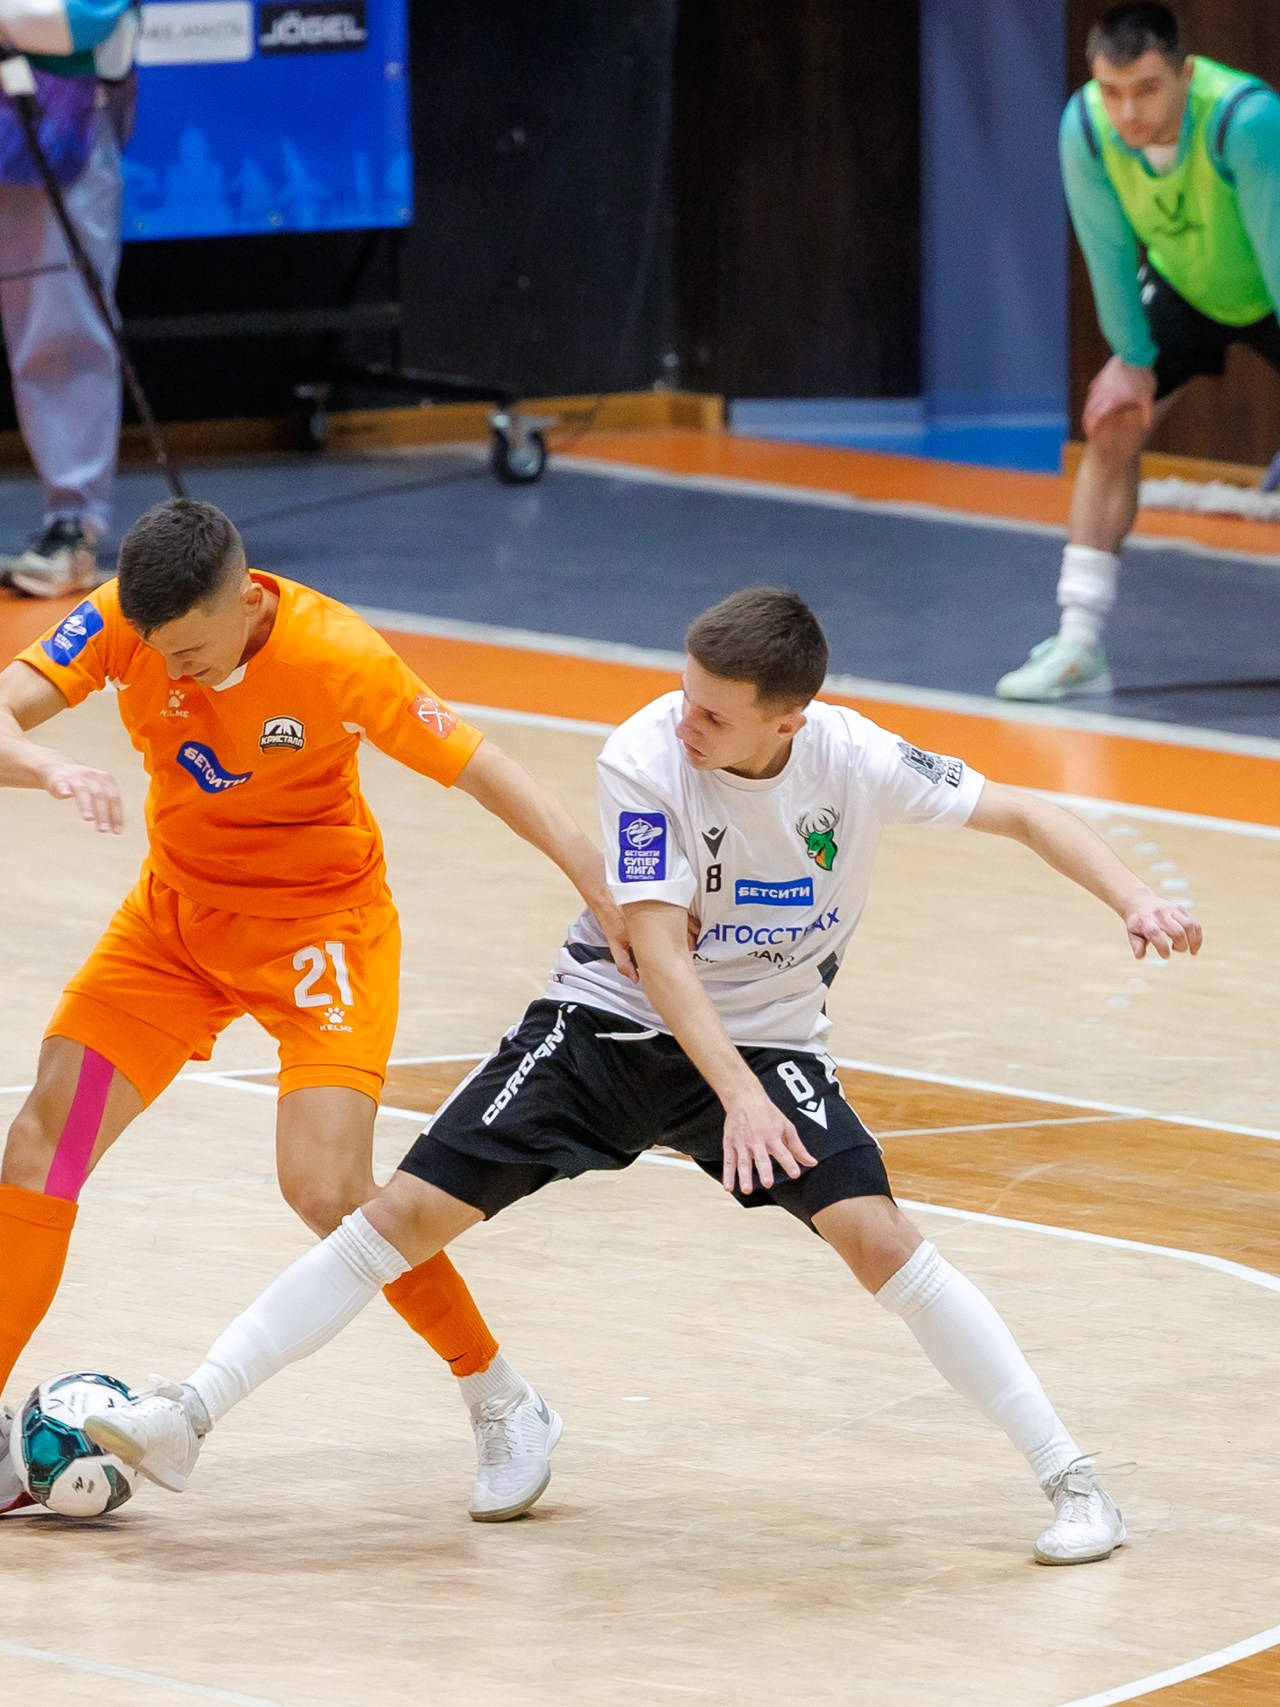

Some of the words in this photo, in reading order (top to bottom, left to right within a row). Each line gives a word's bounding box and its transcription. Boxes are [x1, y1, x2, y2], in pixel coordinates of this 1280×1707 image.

[261, 735, 304, 748] КРИСТАЛЛ
[183, 746, 248, 789] БЕТСИТИ
[624, 857, 660, 866] СУПЕР
[625, 866, 656, 875] ЛИГА
[706, 863, 722, 893] 8
[738, 886, 811, 899] БЕТСИТИ
[293, 941, 354, 1008] 21
[320, 1024, 353, 1033] KELME
[482, 1009, 566, 1126] CORDANT
[776, 1060, 815, 1103] 8
